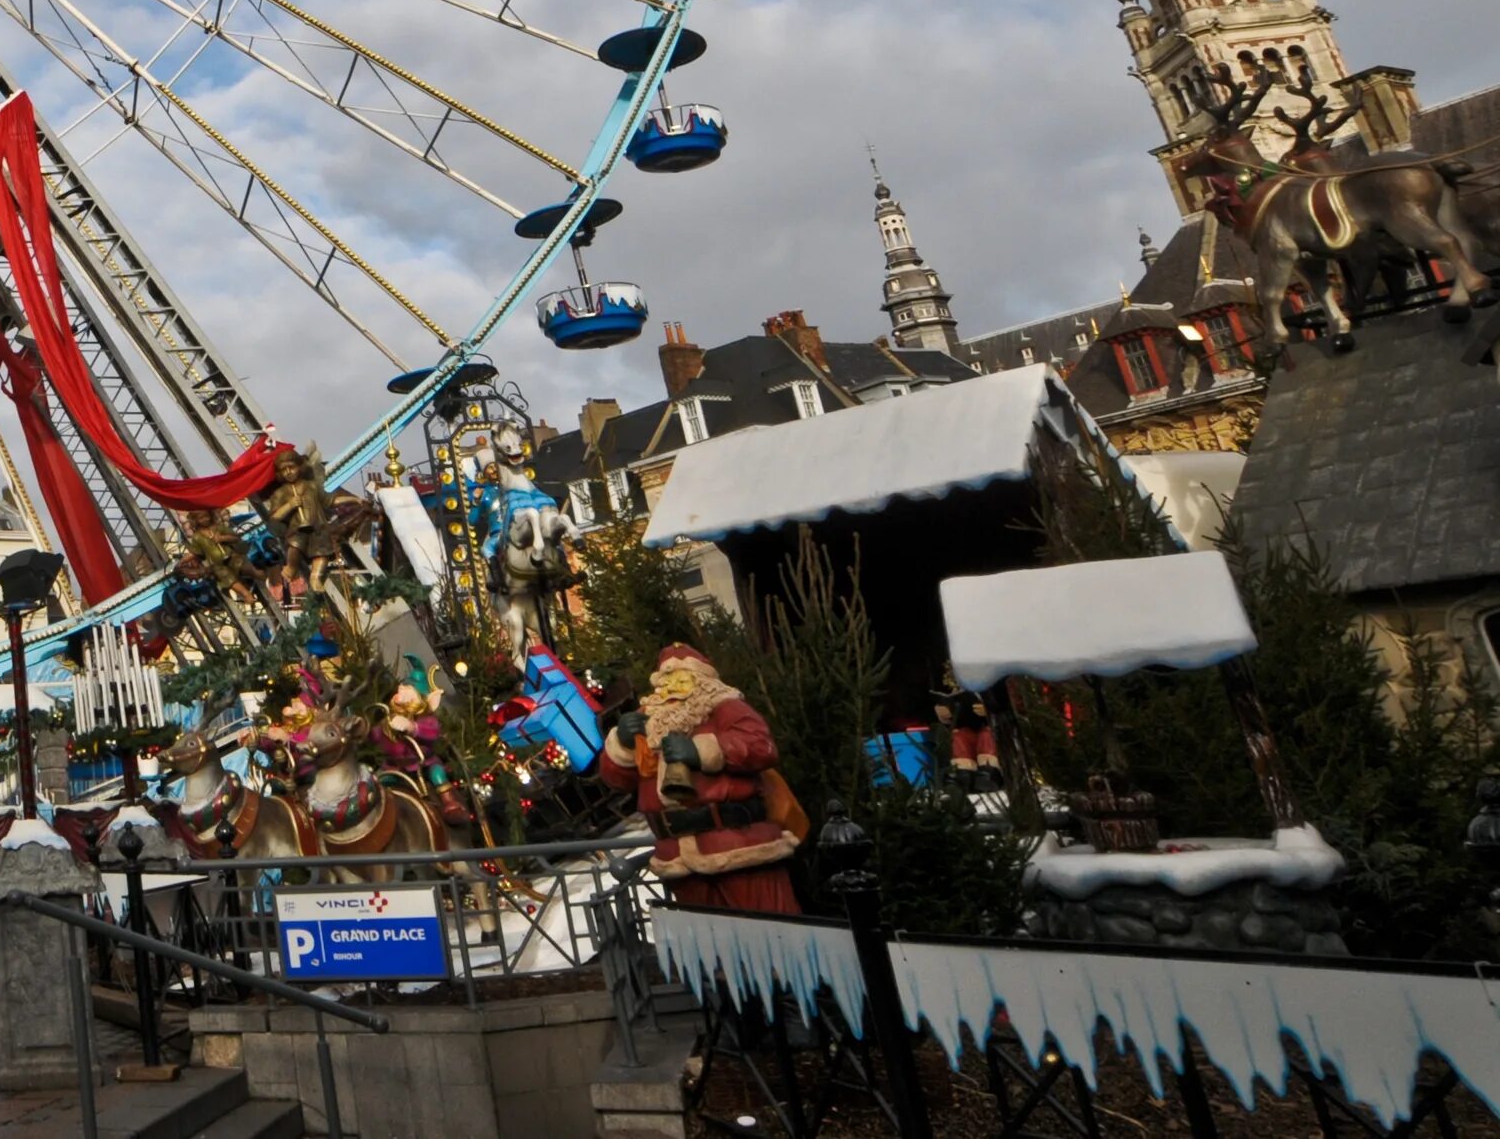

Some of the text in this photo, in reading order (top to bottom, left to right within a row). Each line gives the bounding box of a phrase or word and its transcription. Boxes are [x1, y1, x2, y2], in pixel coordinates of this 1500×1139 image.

[316, 899, 364, 908] VINCI
[330, 928, 426, 942] GRAND PLACE
[286, 929, 315, 968] P
